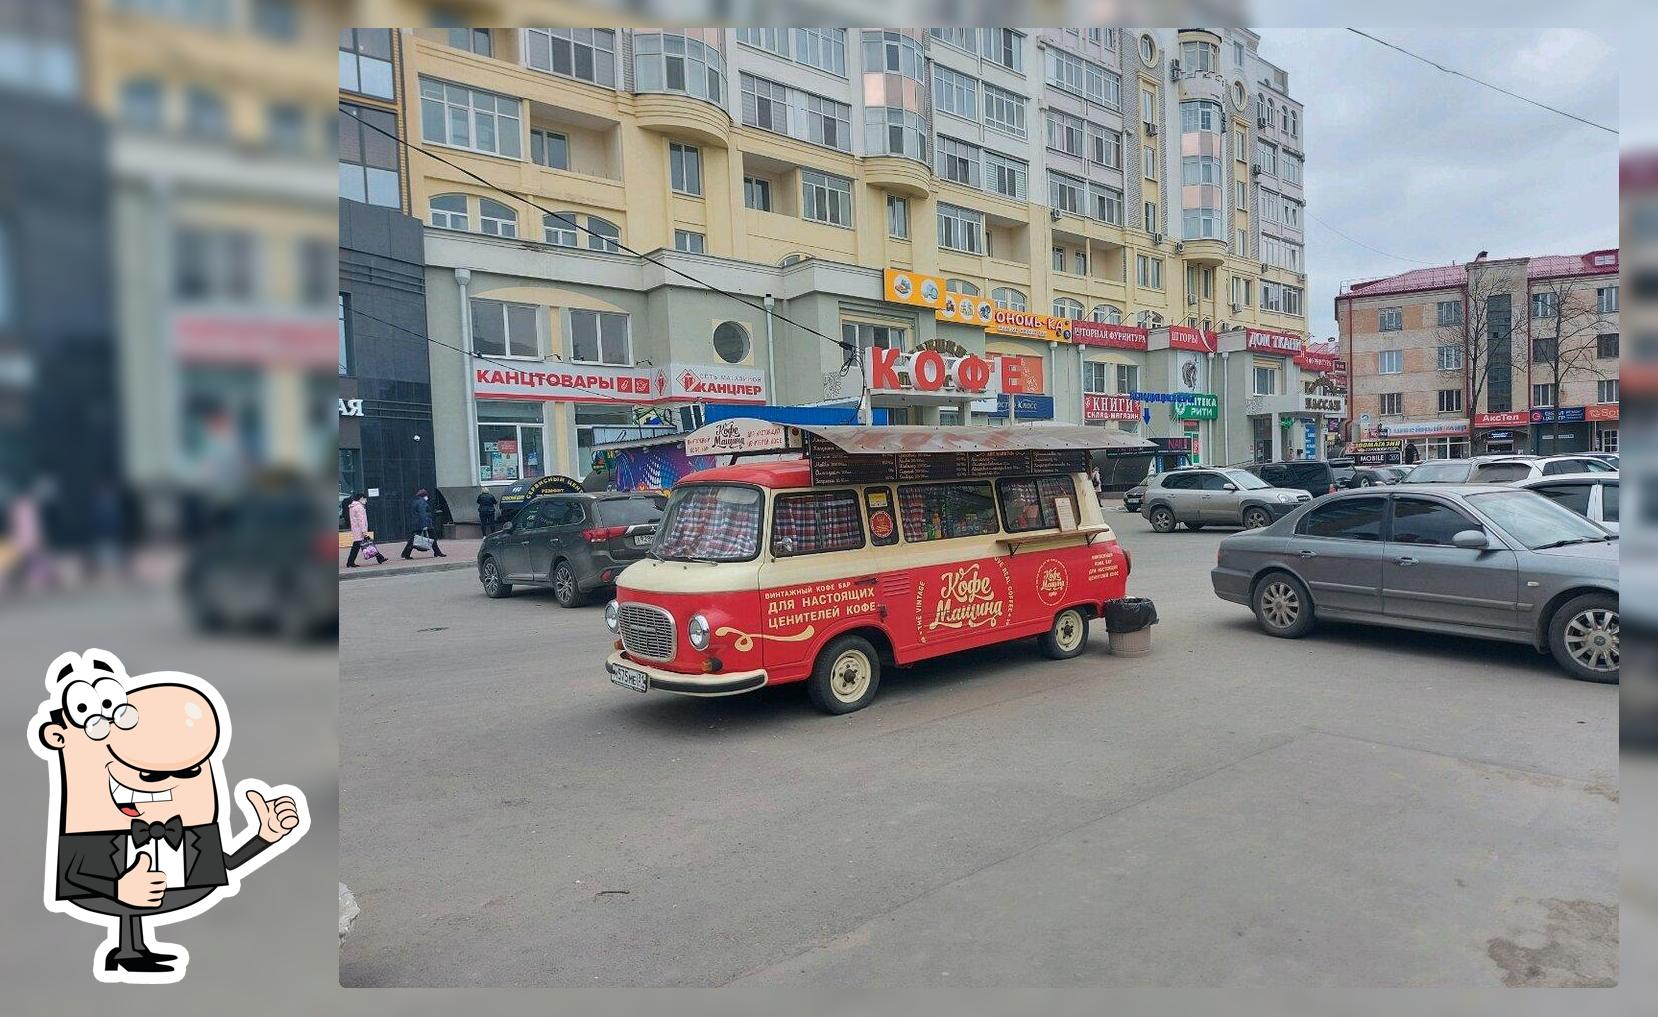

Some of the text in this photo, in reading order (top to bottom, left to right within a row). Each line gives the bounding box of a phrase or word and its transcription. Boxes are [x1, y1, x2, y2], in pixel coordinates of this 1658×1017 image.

[1171, 331, 1199, 344] ШТОРЫ
[1248, 331, 1271, 347] ДОМ
[870, 346, 1022, 394] КОФЕ
[476, 369, 614, 390] КАНЦТОВАРЫ
[697, 382, 762, 396] КАНЦЛЕР
[1093, 396, 1134, 412] КНИГИ
[1087, 411, 1140, 420] СКЛАД-МАГАЗИН
[1482, 413, 1520, 422] АксТел
[715, 421, 741, 438] Кофе
[711, 436, 745, 449] Машина
[1360, 454, 1385, 462] MOBILE
[765, 581, 851, 600] ВИНТАЖНЫЙ КОФЕ БАР
[940, 563, 995, 603] Кофе
[768, 587, 875, 615] ДЛЯ НАСТОЯЩИХ
[915, 580, 926, 613] VINTAGE
[768, 601, 877, 630] ЦЕНИТЕЛЕЙ КОФЕ
[929, 598, 1003, 630] Машина
